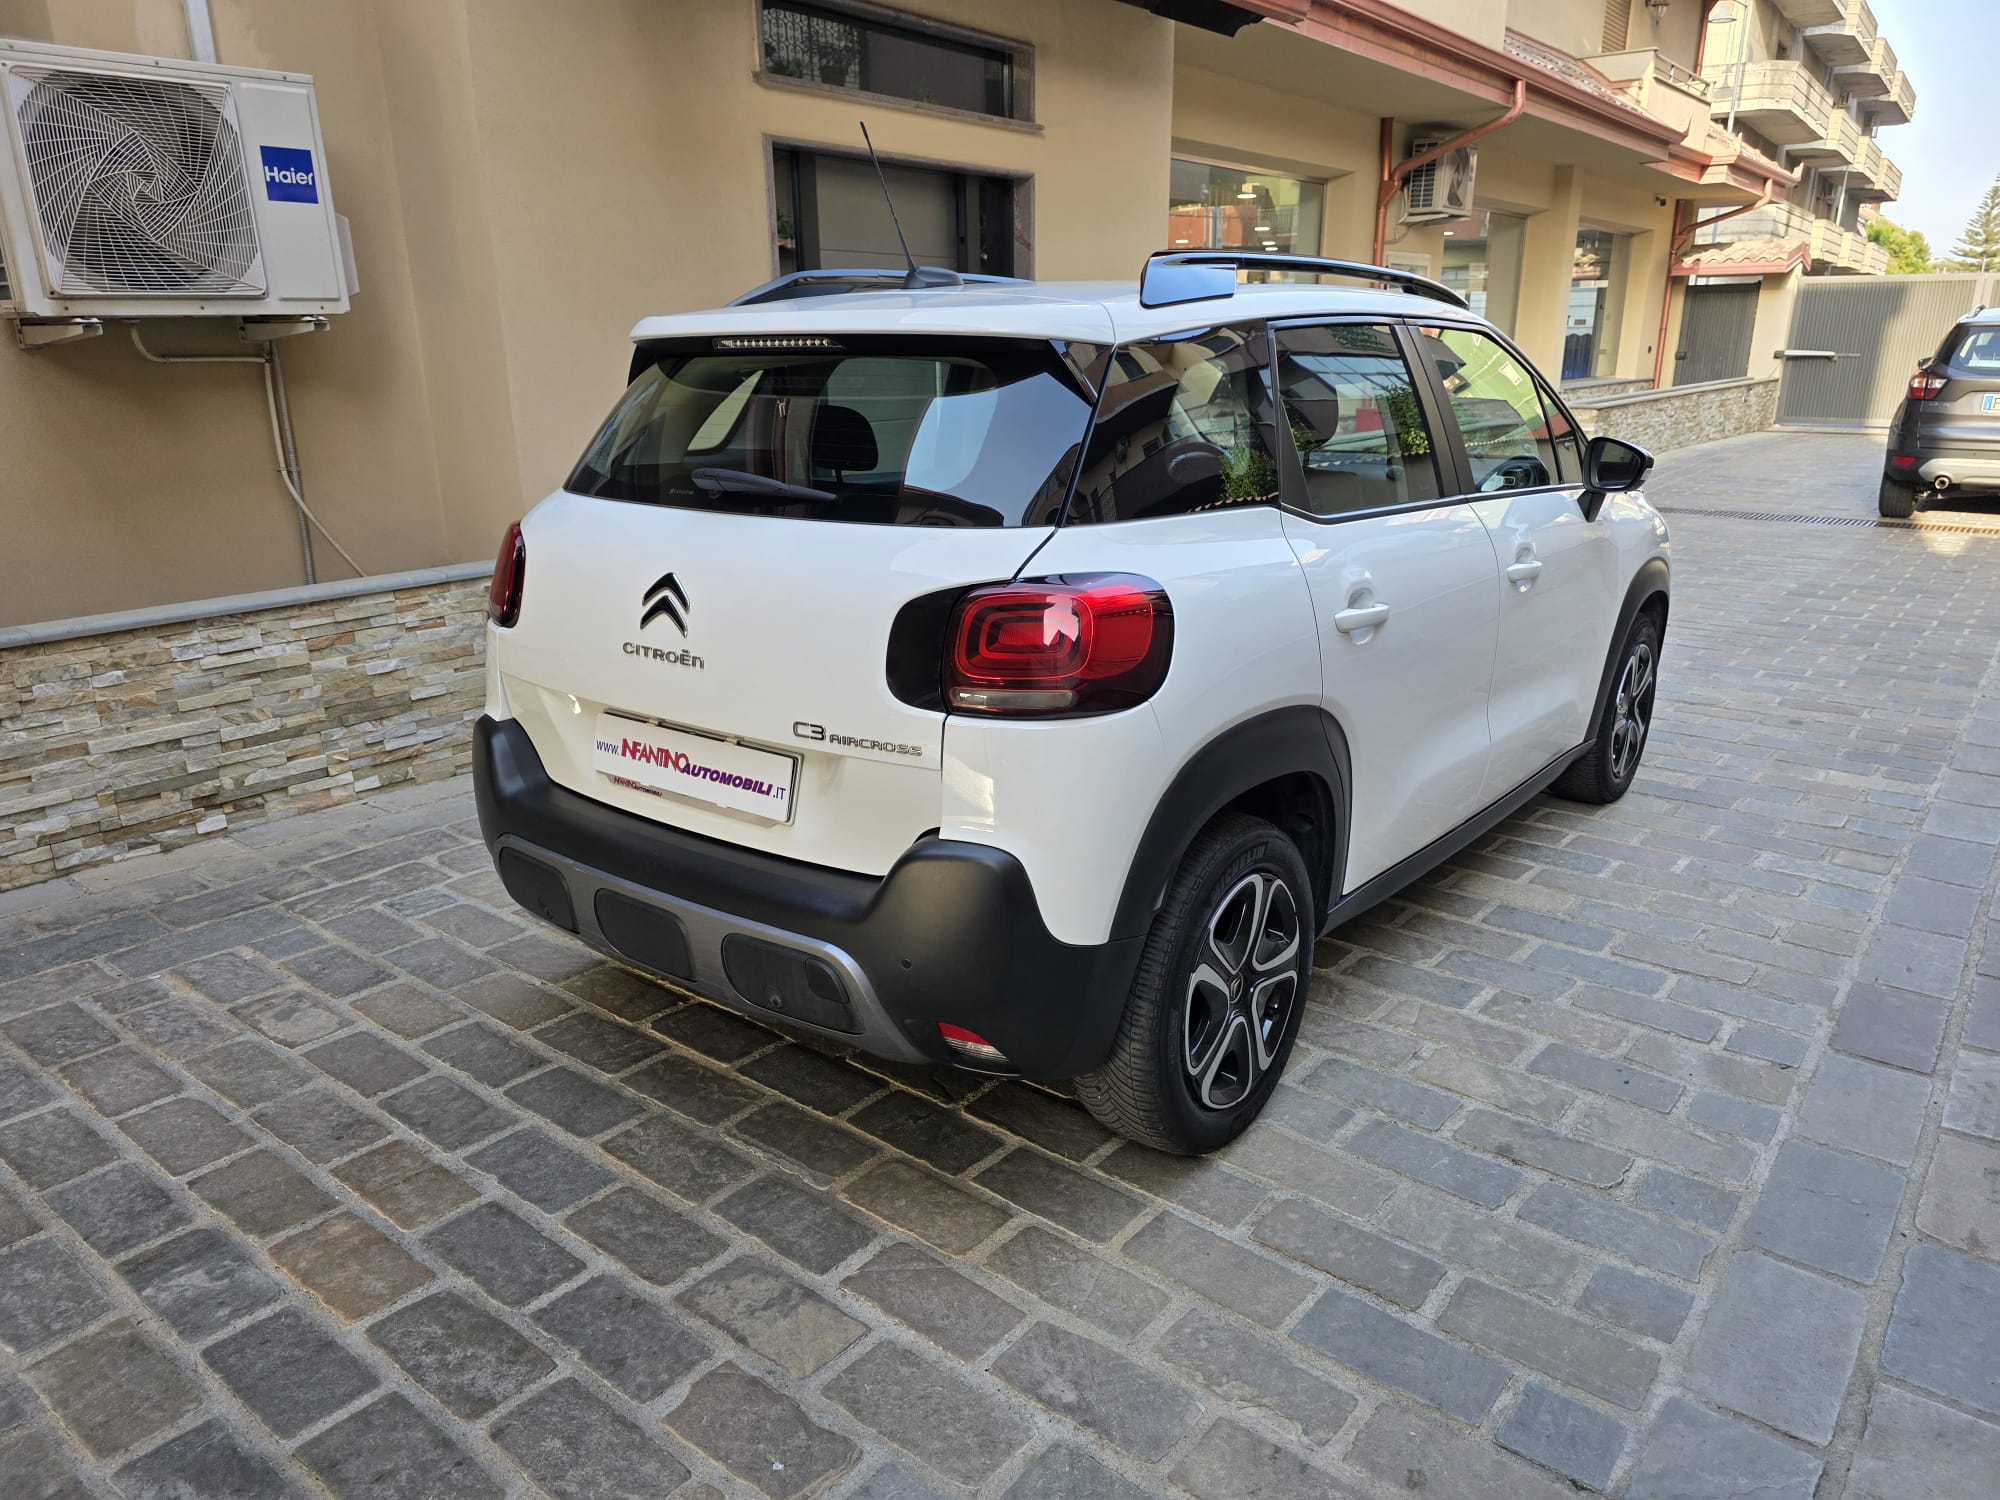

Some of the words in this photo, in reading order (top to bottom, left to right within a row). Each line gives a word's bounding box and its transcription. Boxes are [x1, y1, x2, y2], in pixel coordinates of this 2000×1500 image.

[264, 165, 313, 185] Haier
[793, 721, 826, 741] C3
[829, 734, 922, 757] AIRCROSS
